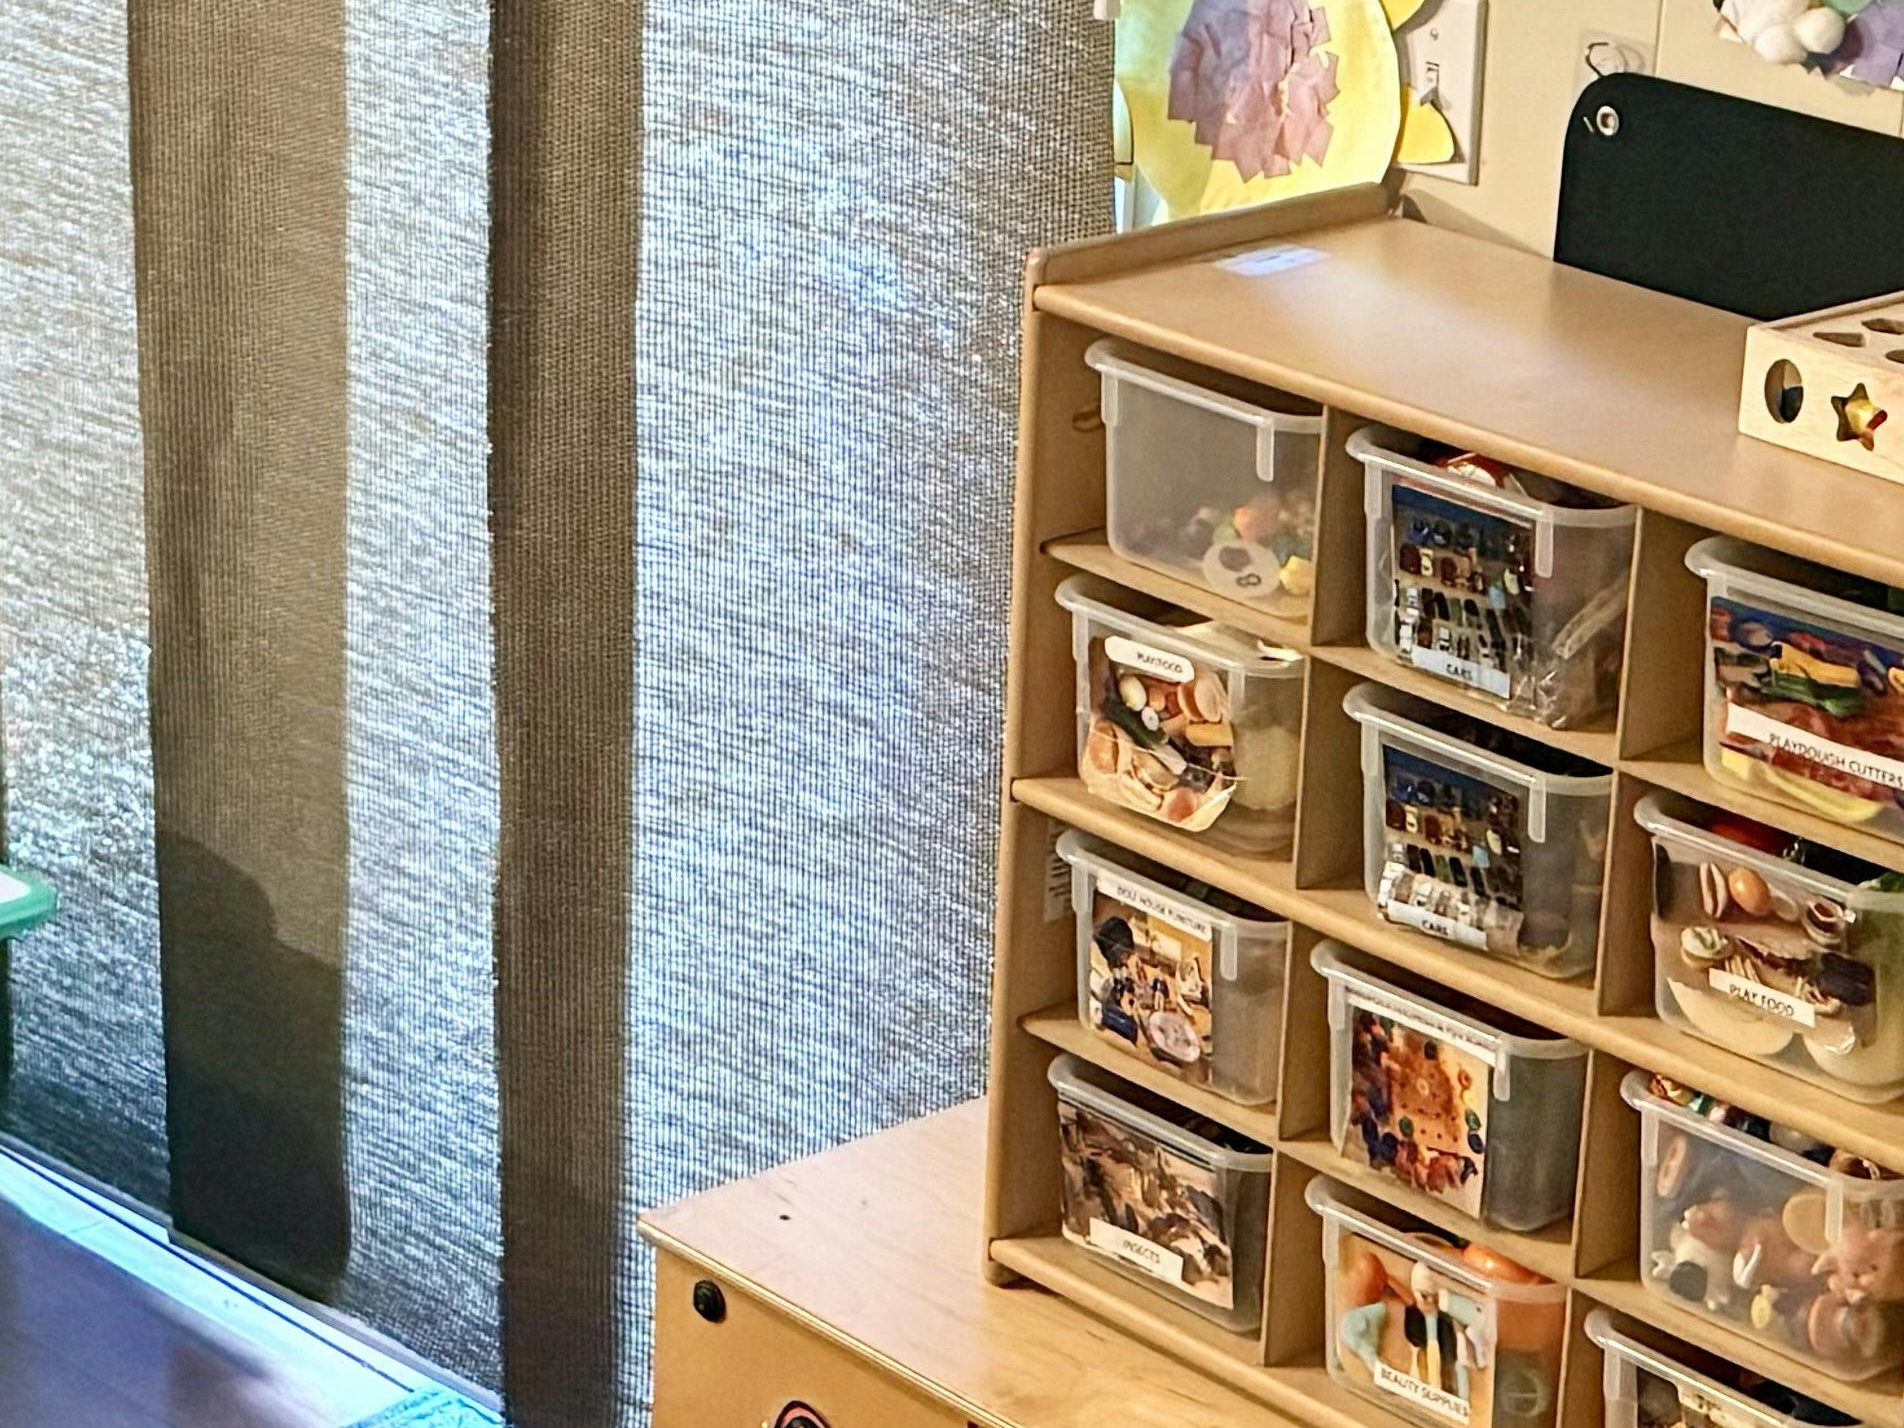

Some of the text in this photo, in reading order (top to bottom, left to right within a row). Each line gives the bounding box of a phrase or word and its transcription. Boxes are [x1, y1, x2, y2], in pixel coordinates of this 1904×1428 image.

[1768, 732, 1904, 789] PLAYDOUGH CUTTERS
[1728, 983, 1795, 1018] PLAY FOOD
[1380, 1367, 1469, 1418] BEAUTY SUPPLIES
